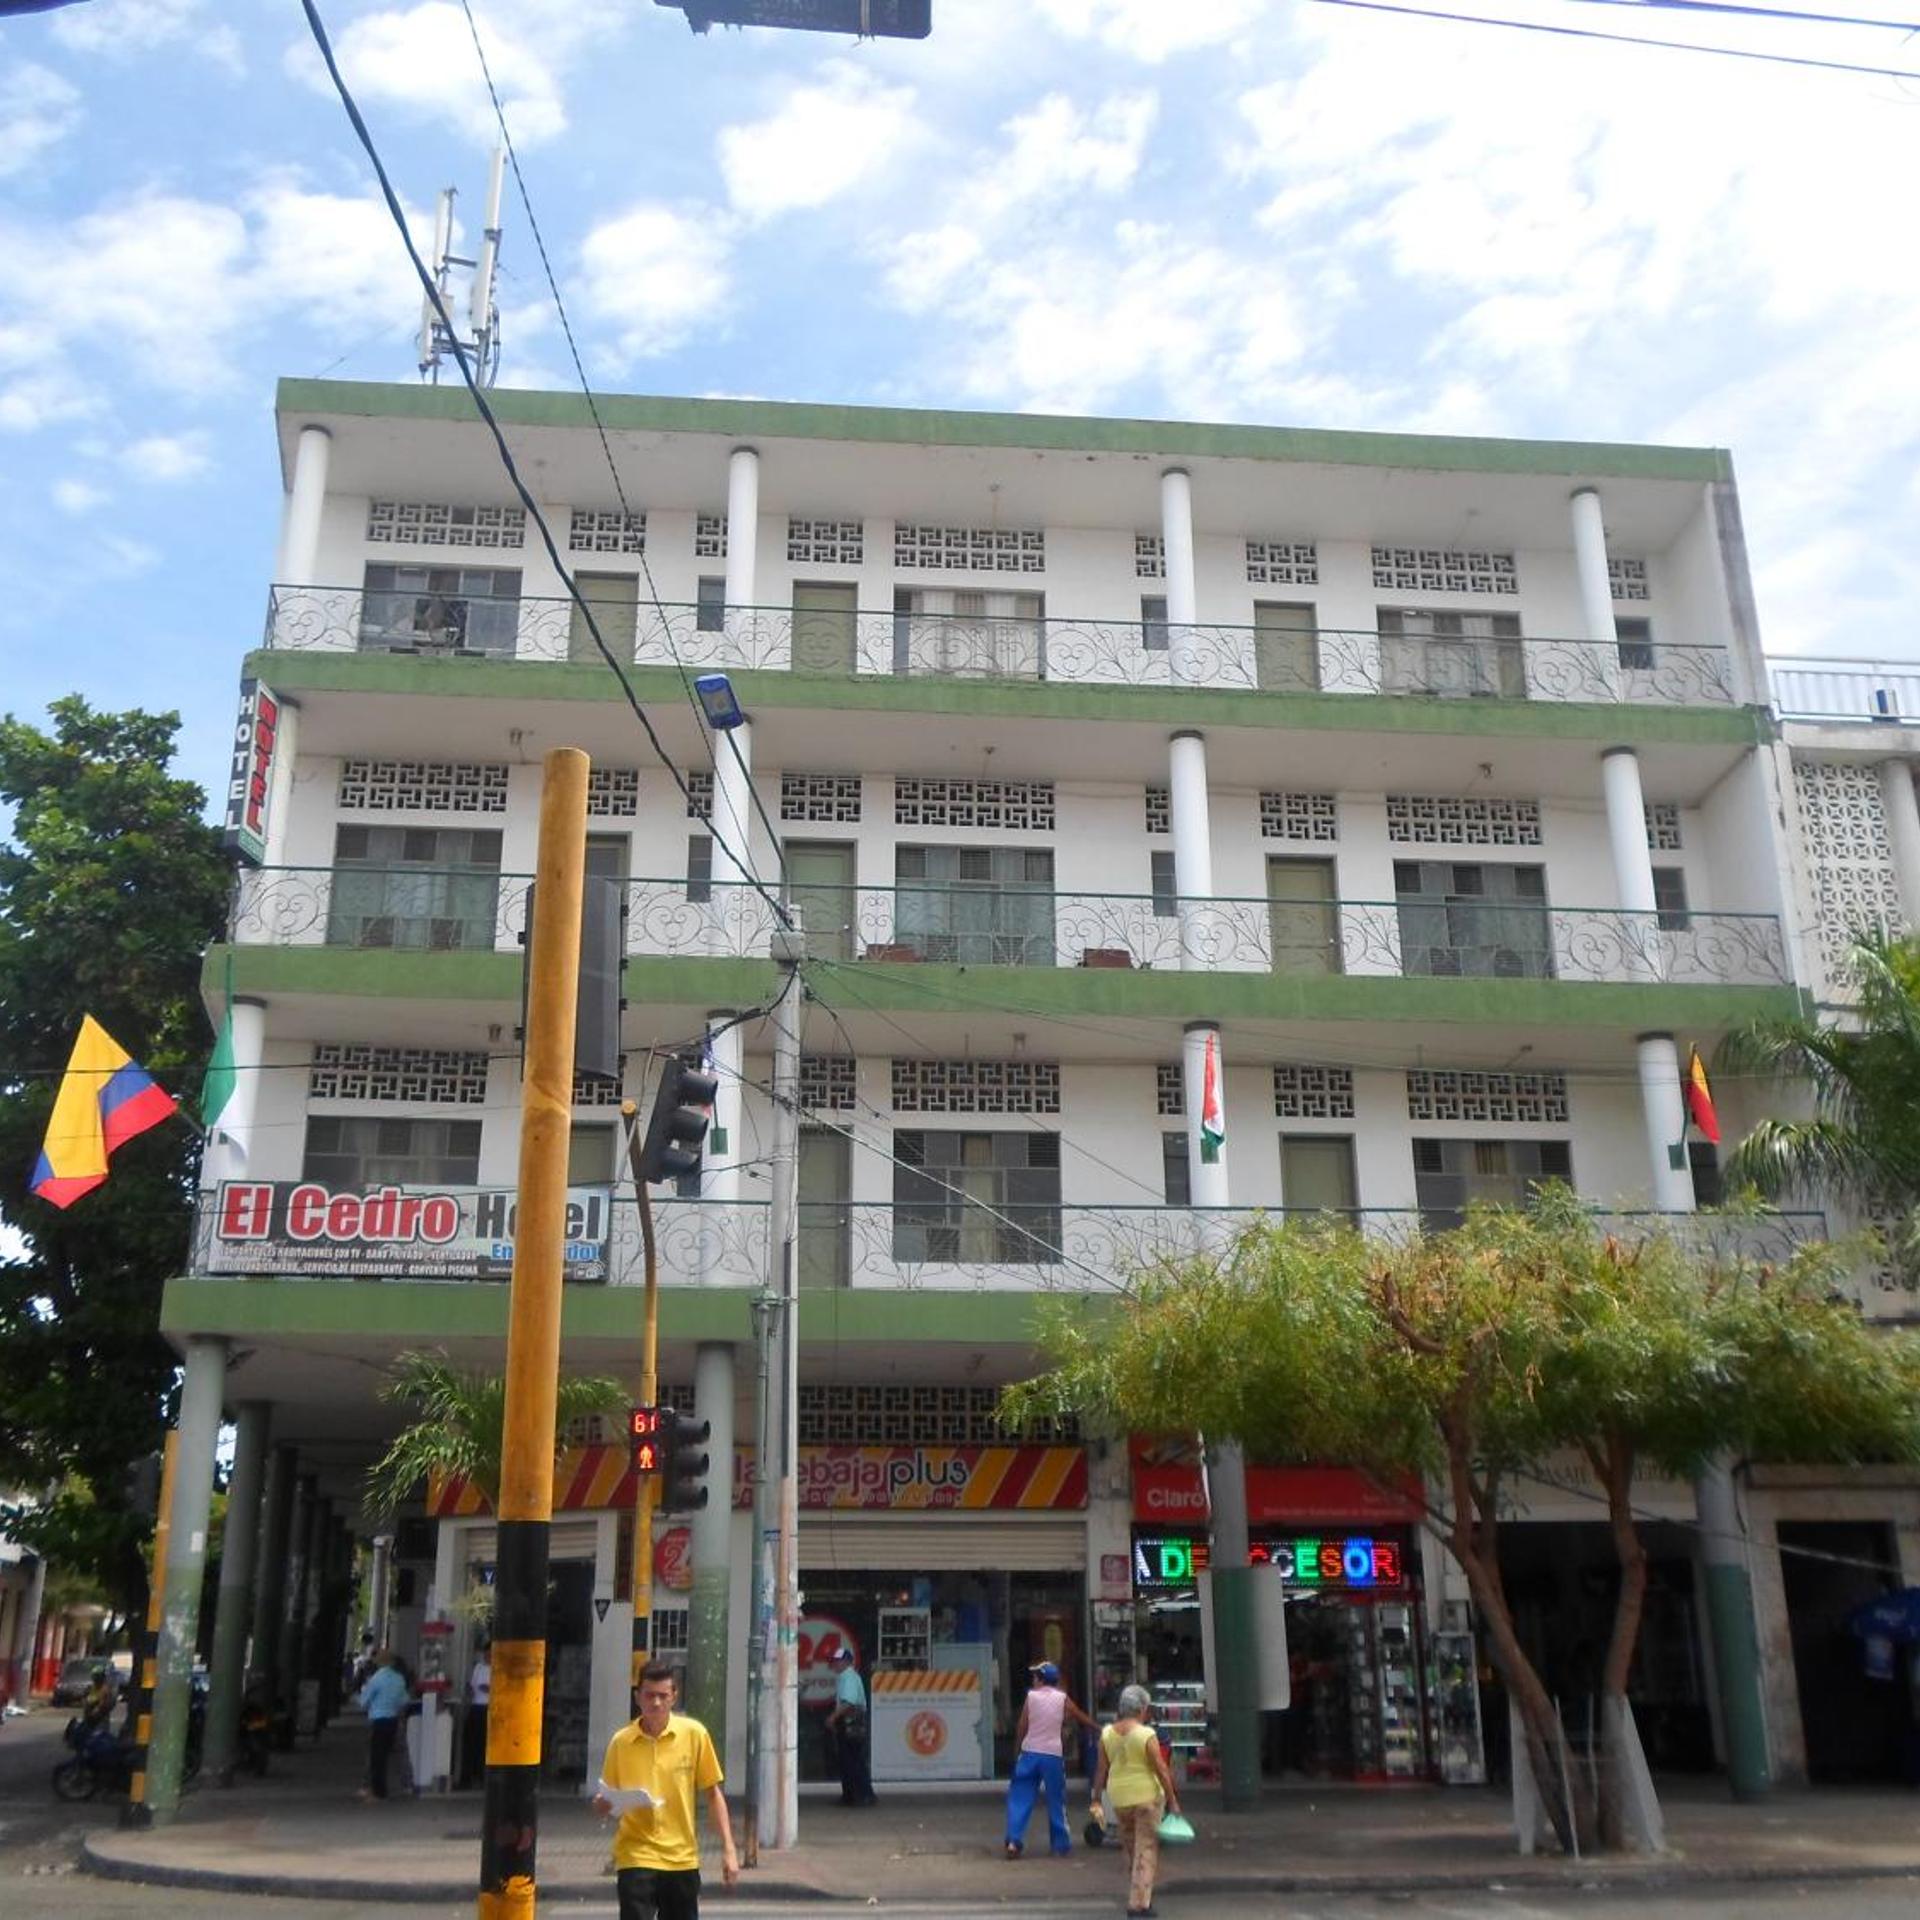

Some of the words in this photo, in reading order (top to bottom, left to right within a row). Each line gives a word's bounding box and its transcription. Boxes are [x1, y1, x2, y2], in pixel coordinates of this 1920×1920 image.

[226, 695, 254, 831] HOTEL
[221, 1185, 272, 1237] El
[289, 1186, 458, 1240] Cedro
[475, 1193, 601, 1240] Hel
[635, 1414, 655, 1433] 61
[889, 1450, 968, 1492] plus
[1146, 1487, 1205, 1509] Claro
[1249, 1546, 1396, 1577] CCESOR
